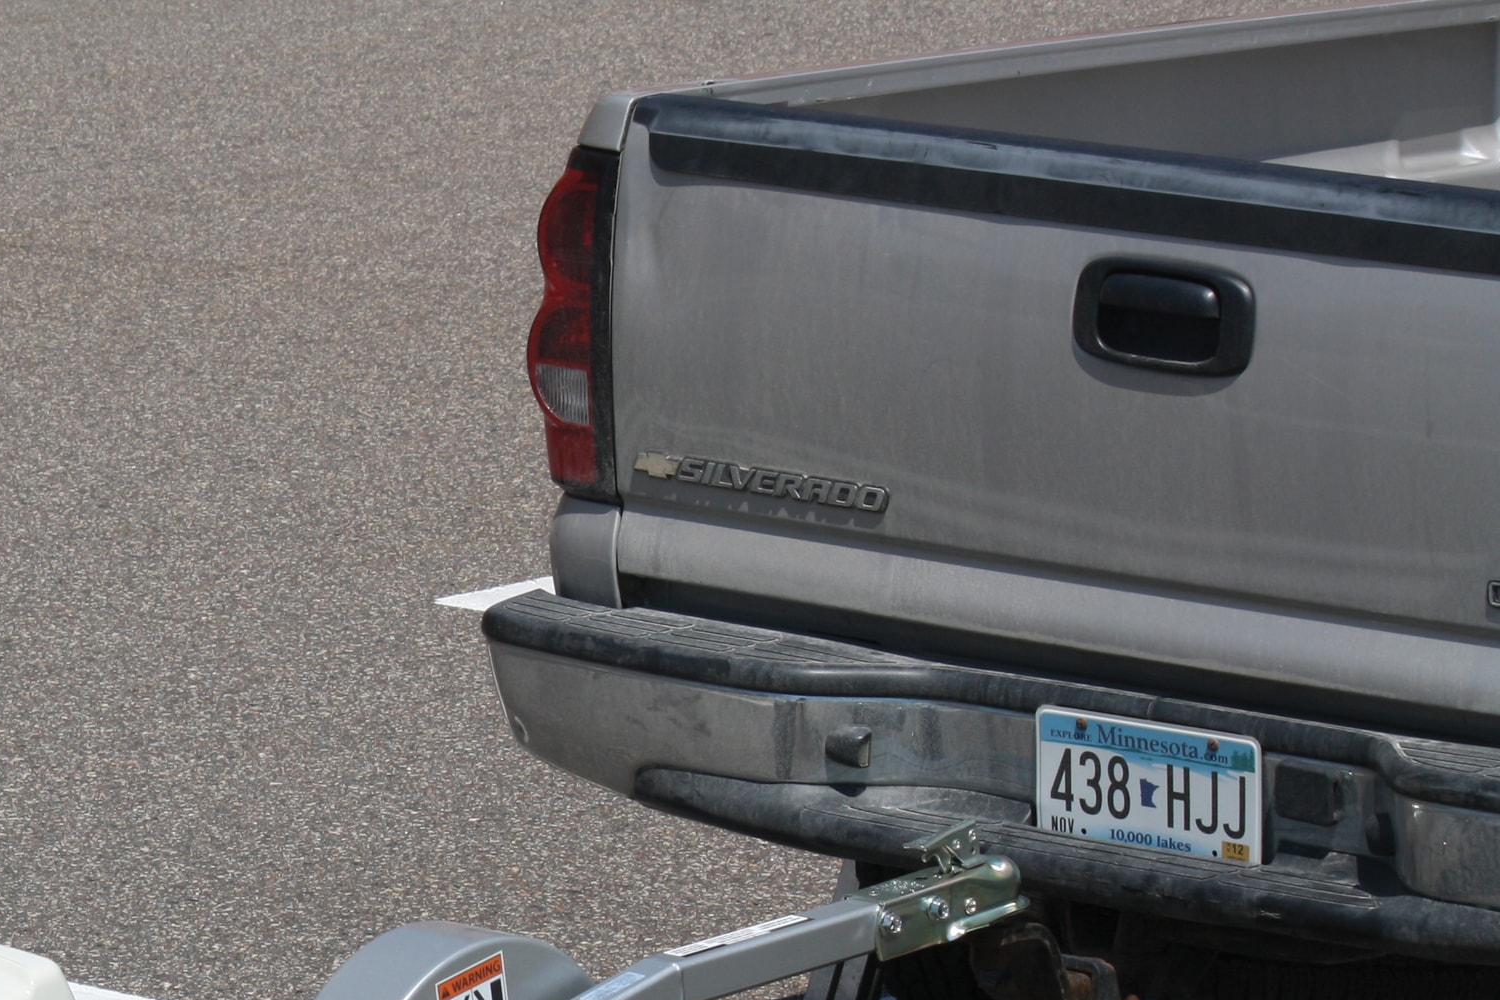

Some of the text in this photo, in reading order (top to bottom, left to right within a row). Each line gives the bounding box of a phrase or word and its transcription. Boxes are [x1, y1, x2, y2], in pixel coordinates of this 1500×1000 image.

[677, 456, 889, 513] SILVERADO
[1050, 723, 1229, 765] EXPLORE Minnesota.com
[1050, 748, 1246, 840] 438 HJJ
[1051, 816, 1075, 834] NOV
[1110, 828, 1192, 853] 10,000 lakes
[1233, 843, 1244, 856] 12
[452, 959, 501, 994] WARNING
